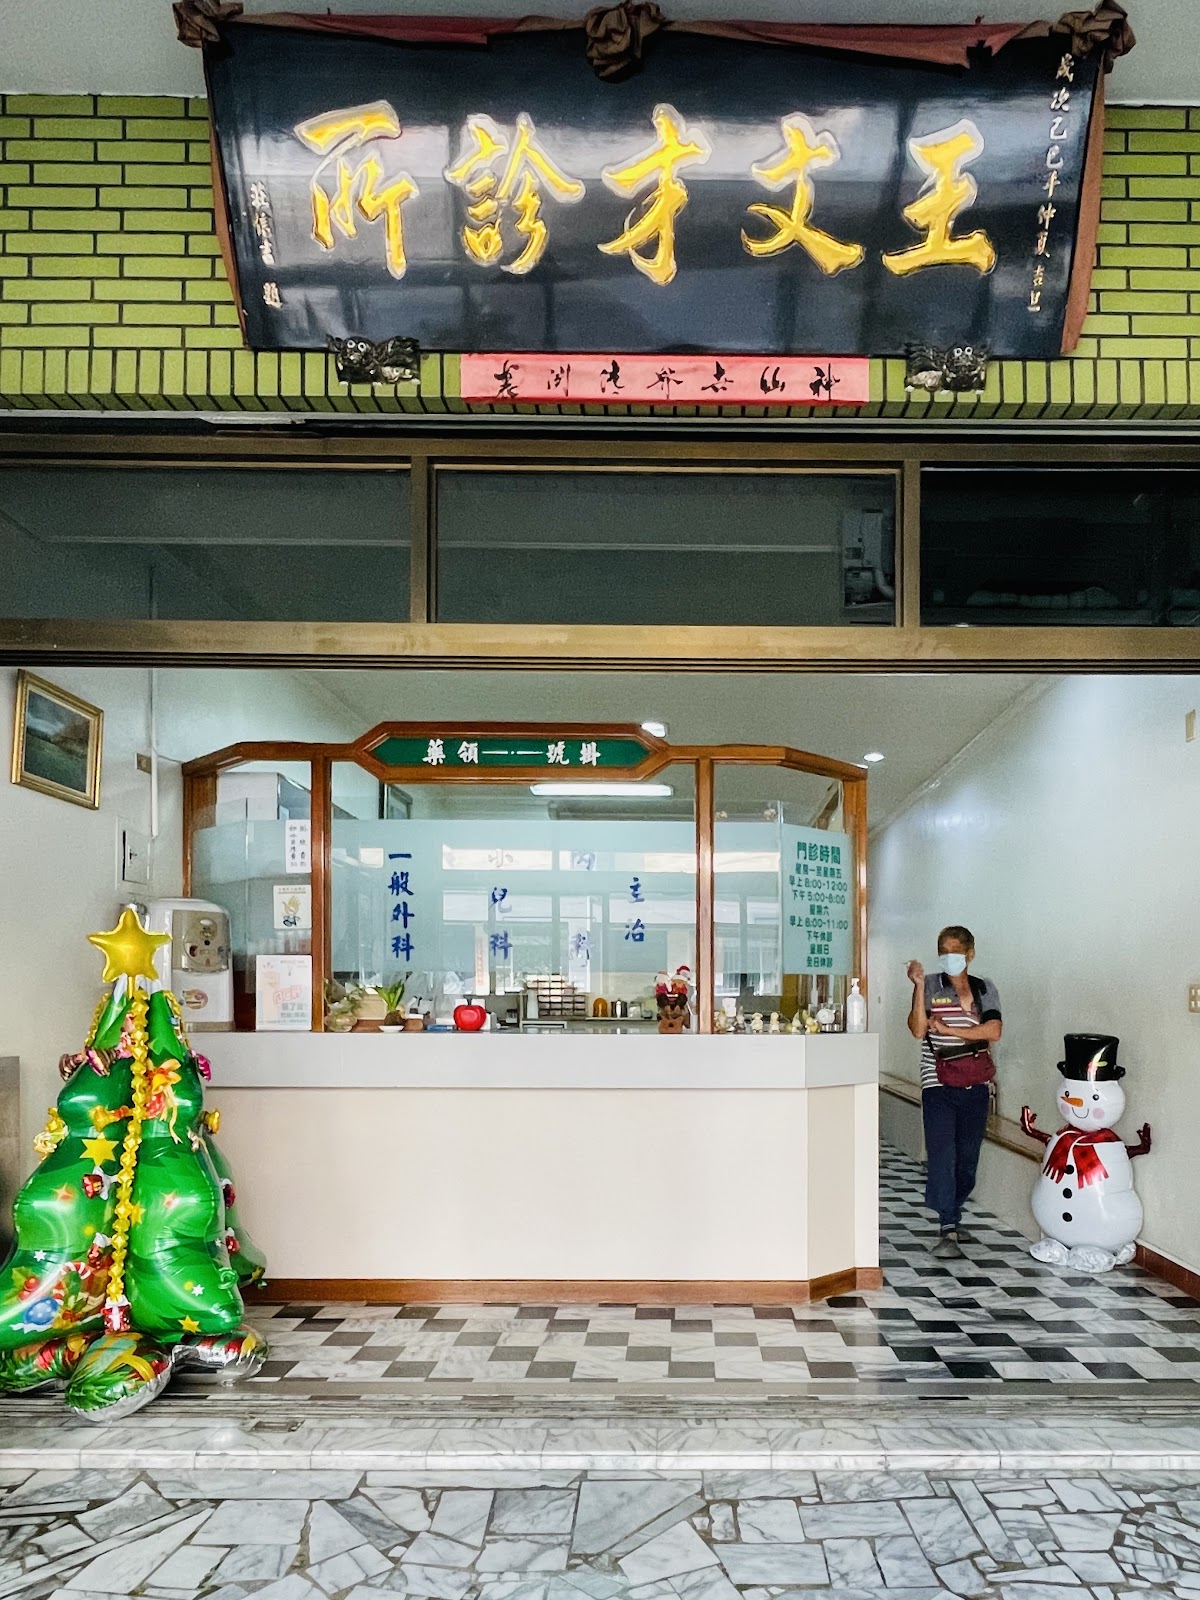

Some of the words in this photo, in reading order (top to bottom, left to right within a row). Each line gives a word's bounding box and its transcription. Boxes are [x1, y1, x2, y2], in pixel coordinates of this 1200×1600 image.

[796, 841, 842, 865] 門診時間
[795, 863, 842, 879] 星期一至星期五
[387, 852, 416, 963] 一般外科
[624, 876, 646, 943] 主治
[809, 904, 830, 917] 星期六
[806, 930, 833, 943] 下午休診
[809, 943, 830, 955] 星期日
[806, 956, 833, 968] 全日休診
